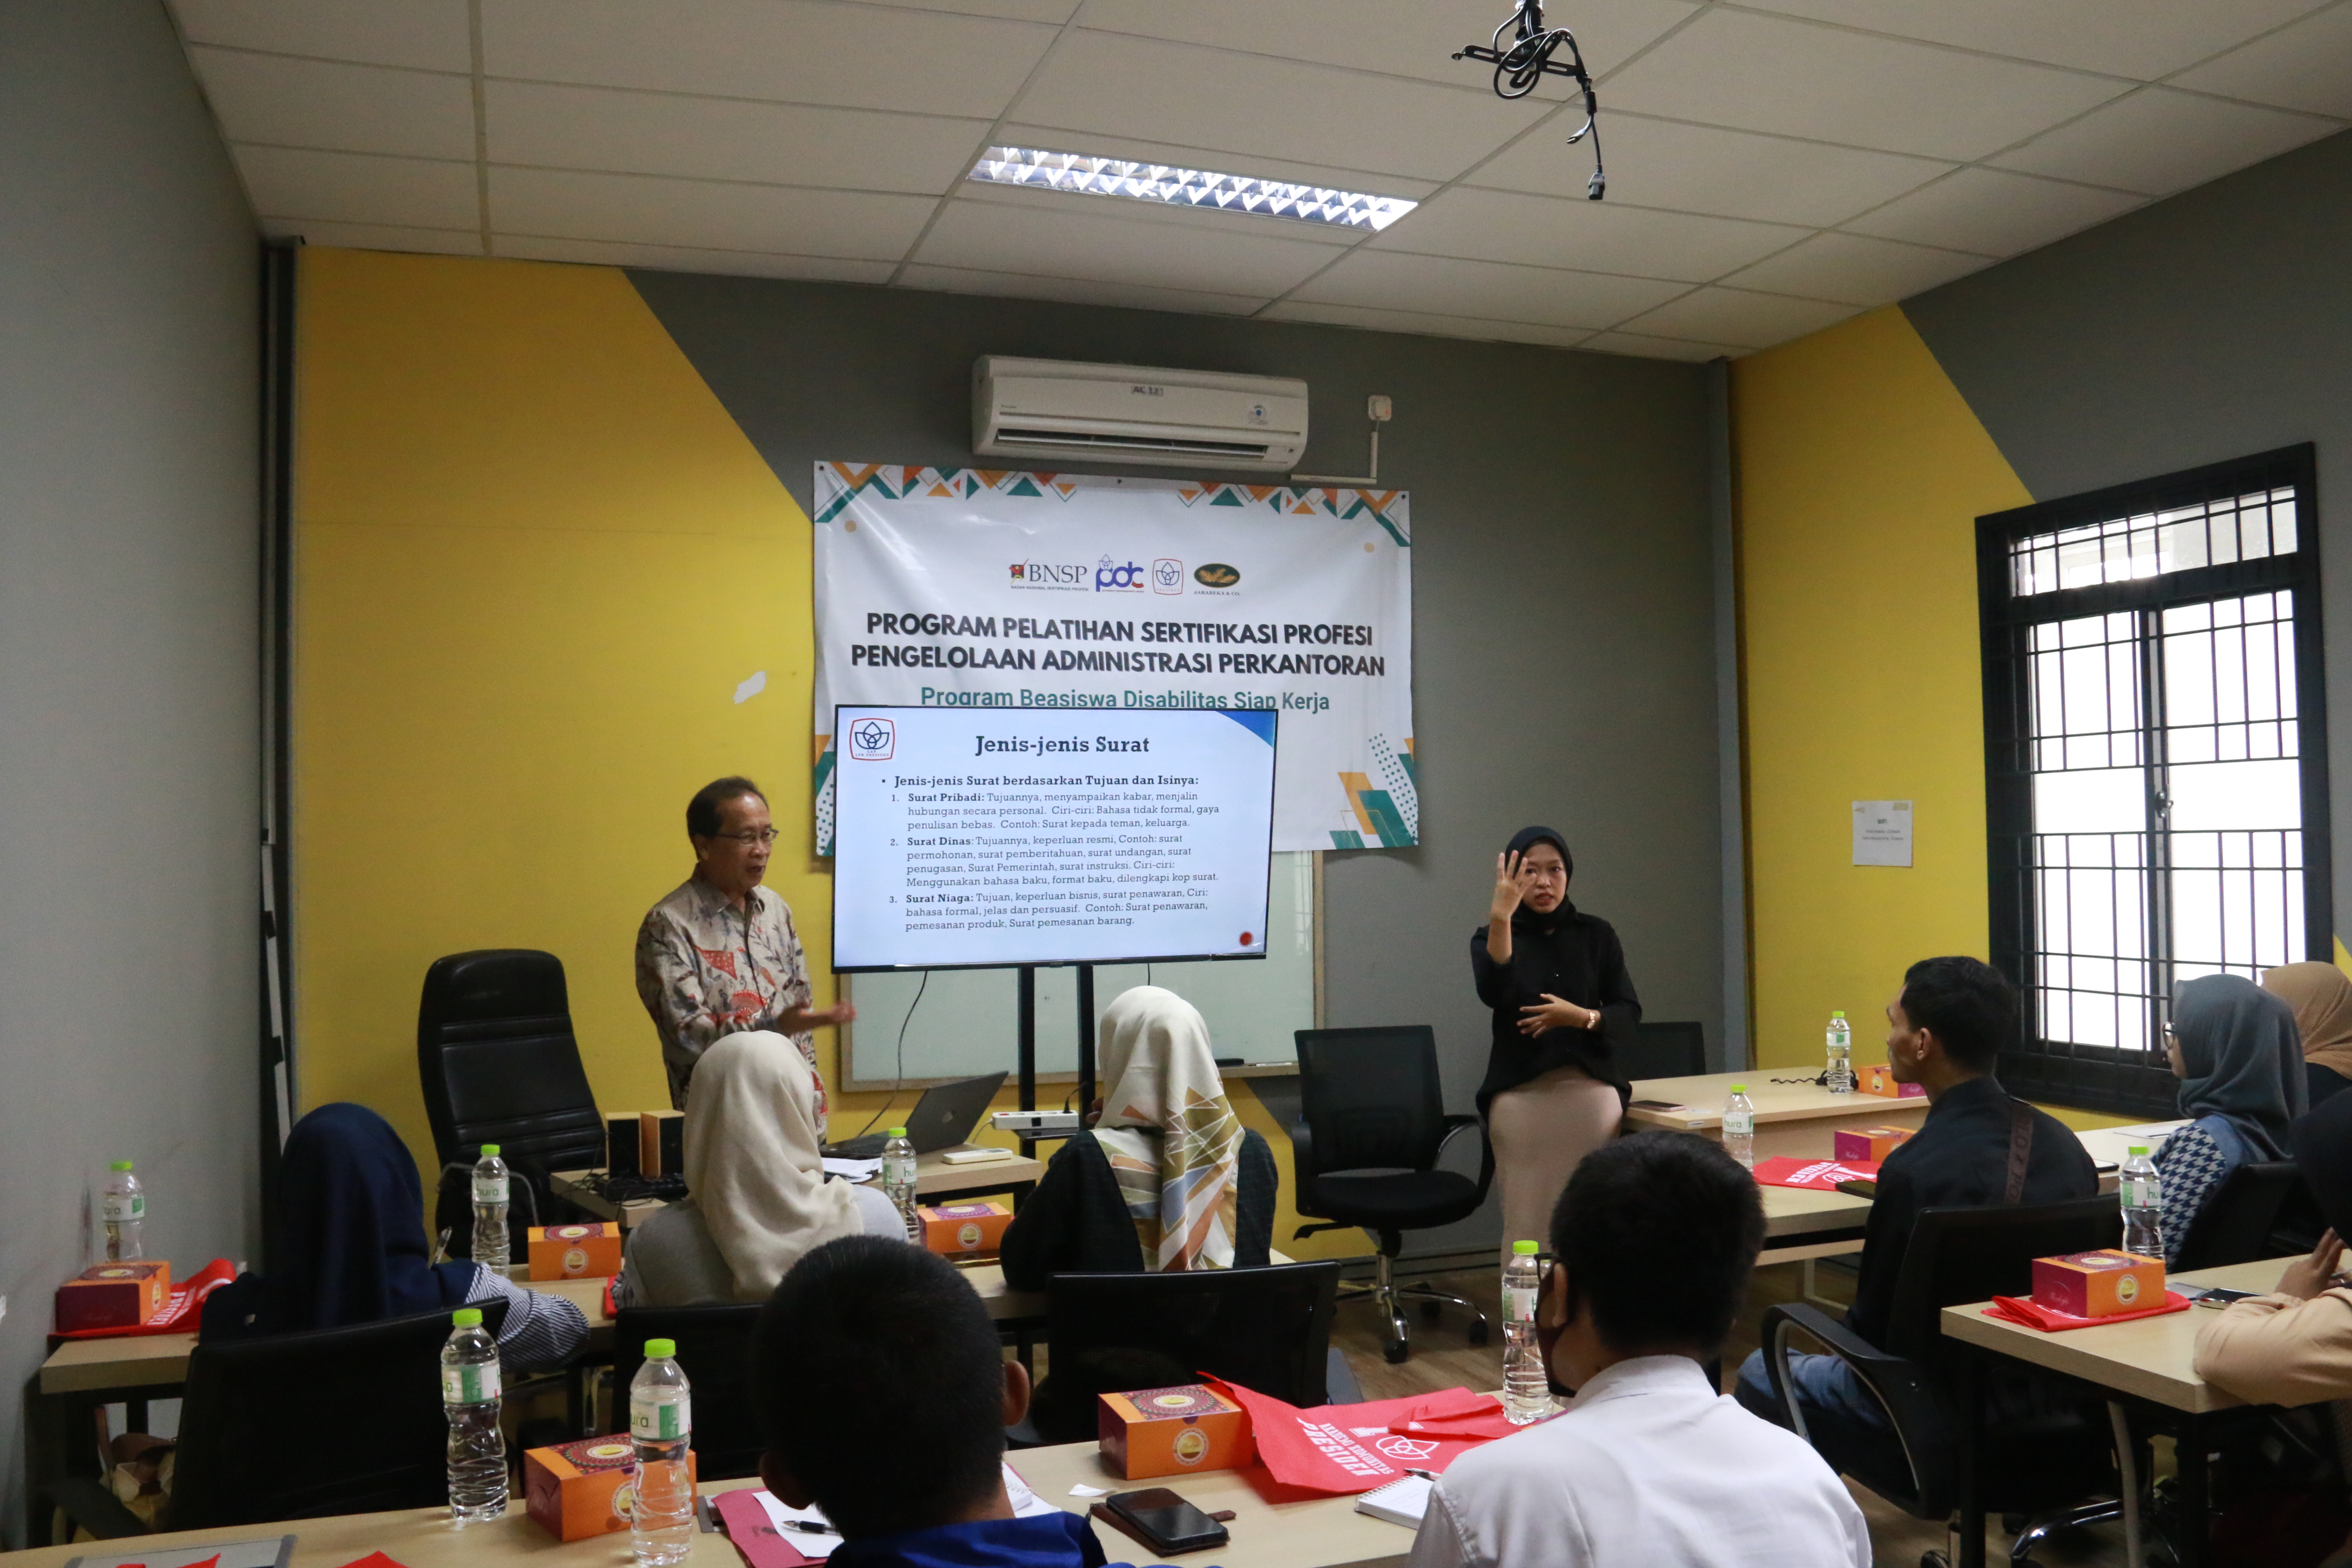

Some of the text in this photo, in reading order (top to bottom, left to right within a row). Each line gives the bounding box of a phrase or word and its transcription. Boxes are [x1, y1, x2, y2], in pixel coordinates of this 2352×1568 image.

[1028, 564, 1087, 583] BNSP
[867, 612, 1372, 646] PROGRAM PELATIHAN SERTIFIKASI PROFESI
[852, 644, 1384, 676] PENGELOLAAN ADMINISTRASI PERKANTORAN
[921, 687, 1329, 714] Program Beasiswa Disabilitas Siap Kerja
[975, 735, 1149, 756] Jenis-jenis Surat
[894, 775, 1198, 788] Jenis-jenis Surat berdasarkan Tujuan dan Isinya:
[909, 793, 937, 802] Surat
[940, 793, 984, 801] Pribadi:
[987, 793, 1041, 803] Tujuannya,
[1044, 793, 1120, 803] menyampaikan
[1123, 792, 1153, 801] kabar,
[1156, 792, 1197, 802] menjalin
[908, 807, 960, 818] hubungan
[999, 806, 1046, 817] personal.
[1052, 806, 1094, 814] Ciri-ciri:
[1134, 805, 1158, 813] tidak
[1161, 805, 1194, 814] formal,
[1197, 807, 1219, 815] gaya
[908, 821, 958, 831] penulisan
[961, 821, 995, 829] bebas.
[1001, 820, 1039, 828] Contoh:
[1042, 820, 1067, 828] Surat
[1071, 819, 1107, 830] kepada
[1145, 818, 1189, 828] keluarga.
[907, 837, 936, 845] Surat
[939, 837, 974, 845] Dinas:
[976, 836, 1030, 847] Tujuannya,
[1033, 836, 1083, 846] keperluan
[1119, 835, 1156, 843] Contoh:
[907, 851, 975, 861] permohonan,
[1006, 849, 1085, 860] pemberitahuan,
[1115, 848, 1165, 858] undangan,
[907, 866, 965, 875] penugasan,
[968, 864, 994, 872] Surat
[997, 863, 1057, 871] Pemerintah,
[1087, 861, 1130, 870] instruksi.
[906, 877, 980, 888] Menggunakan
[1022, 876, 1050, 885] baku,
[1087, 875, 1114, 883] baku,
[1117, 874, 1169, 884] dilengkapi
[1172, 873, 1190, 883] kop
[906, 894, 934, 903] Surat
[937, 894, 973, 904] Niaga:
[976, 893, 1013, 903] Tujuan,
[1016, 892, 1066, 903] keperluan
[1129, 891, 1185, 900] penawaran,
[906, 908, 942, 916] bahasa
[946, 907, 981, 916] formal,
[983, 906, 1007, 916] jelas
[1032, 904, 1080, 916] persuasif.
[1085, 903, 1123, 912] Contoh:
[1153, 903, 1207, 912] penawaran,
[906, 917, 1134, 932] pemesanan produk, Surat pemesanan barang.
